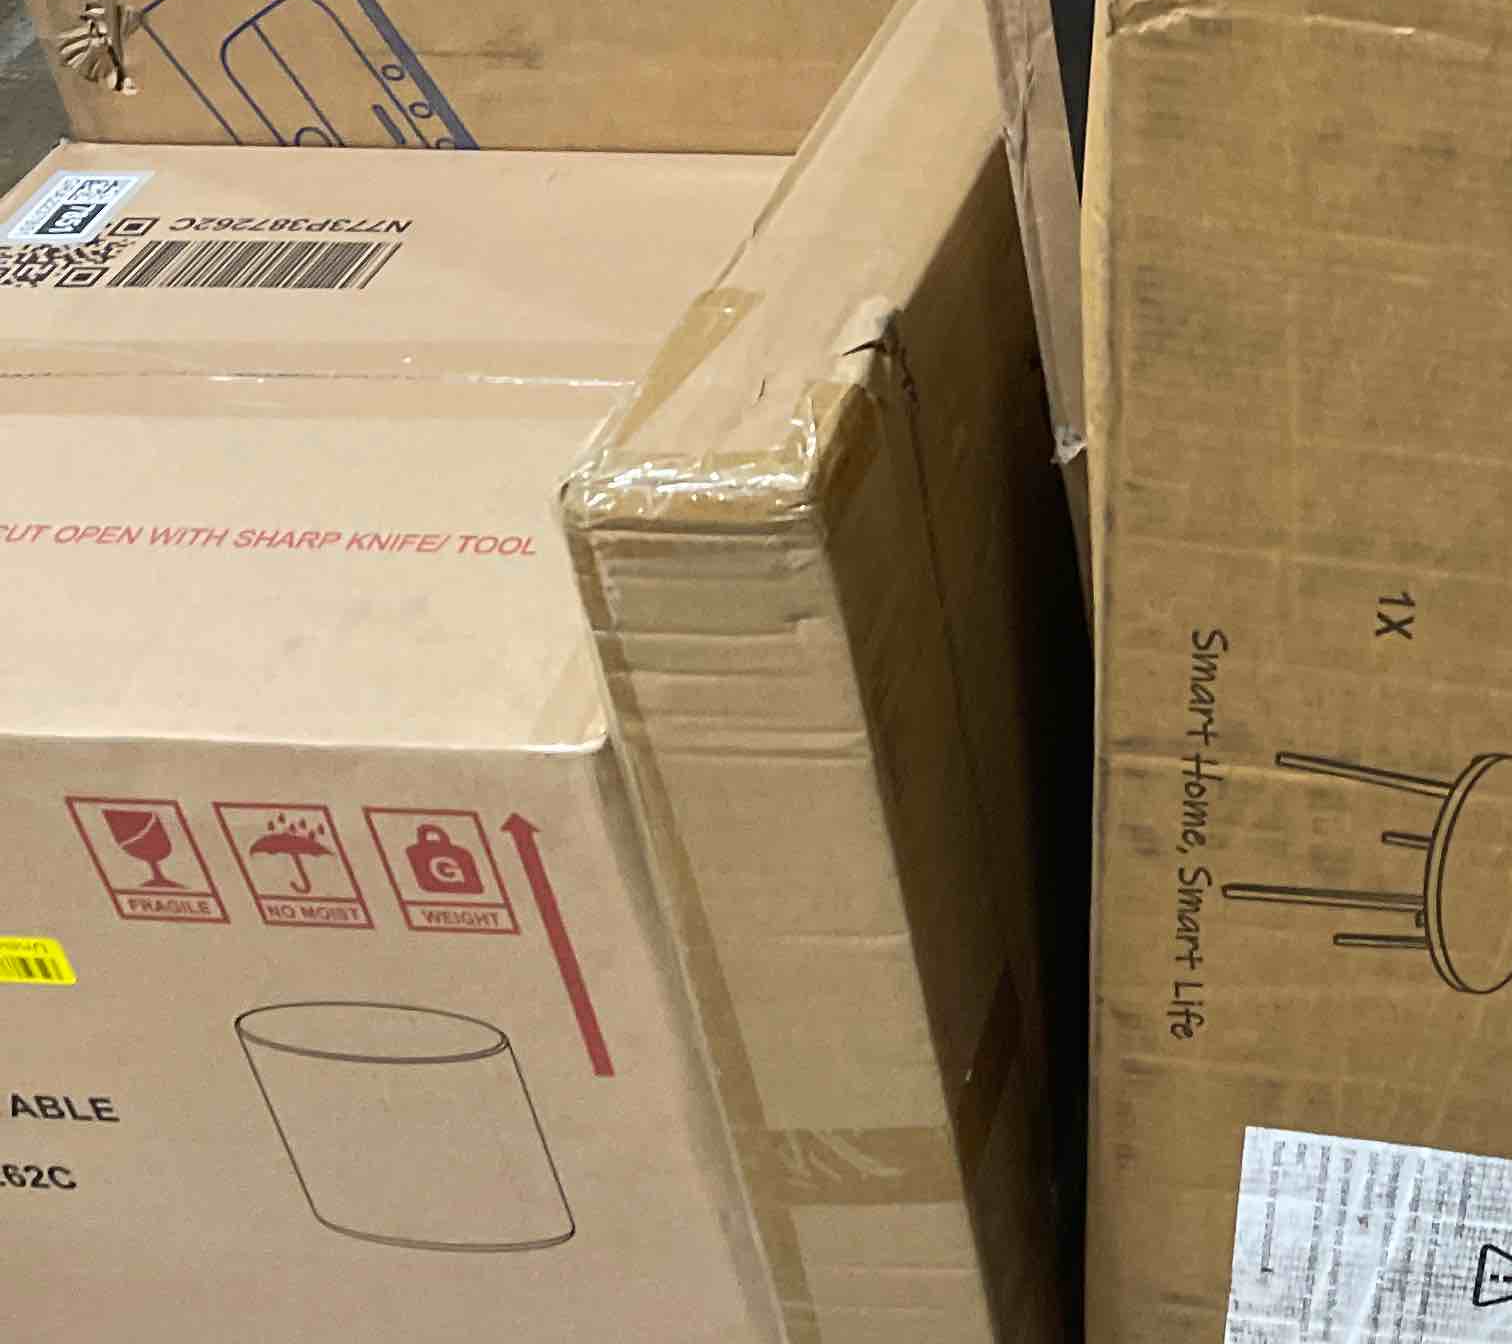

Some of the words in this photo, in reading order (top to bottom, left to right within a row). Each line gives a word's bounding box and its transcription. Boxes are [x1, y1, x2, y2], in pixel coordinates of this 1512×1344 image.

[168, 216, 414, 235] N773P387262C
[54, 525, 144, 545] OPEN
[149, 527, 230, 548] WITH
[233, 528, 342, 550] SHARP
[457, 534, 538, 556] TOOL
[1375, 592, 1416, 641] 1X
[1186, 628, 1229, 746] Smart
[1176, 752, 1225, 854] Home,
[430, 855, 466, 884] G
[126, 896, 212, 916] FRAGILE
[265, 903, 297, 920] NO
[301, 905, 360, 922] MOIST
[420, 909, 502, 928] WEIGHT
[1175, 866, 1213, 971] Smart
[1167, 982, 1205, 1040] Life
[0, 1163, 77, 1190] 62C
